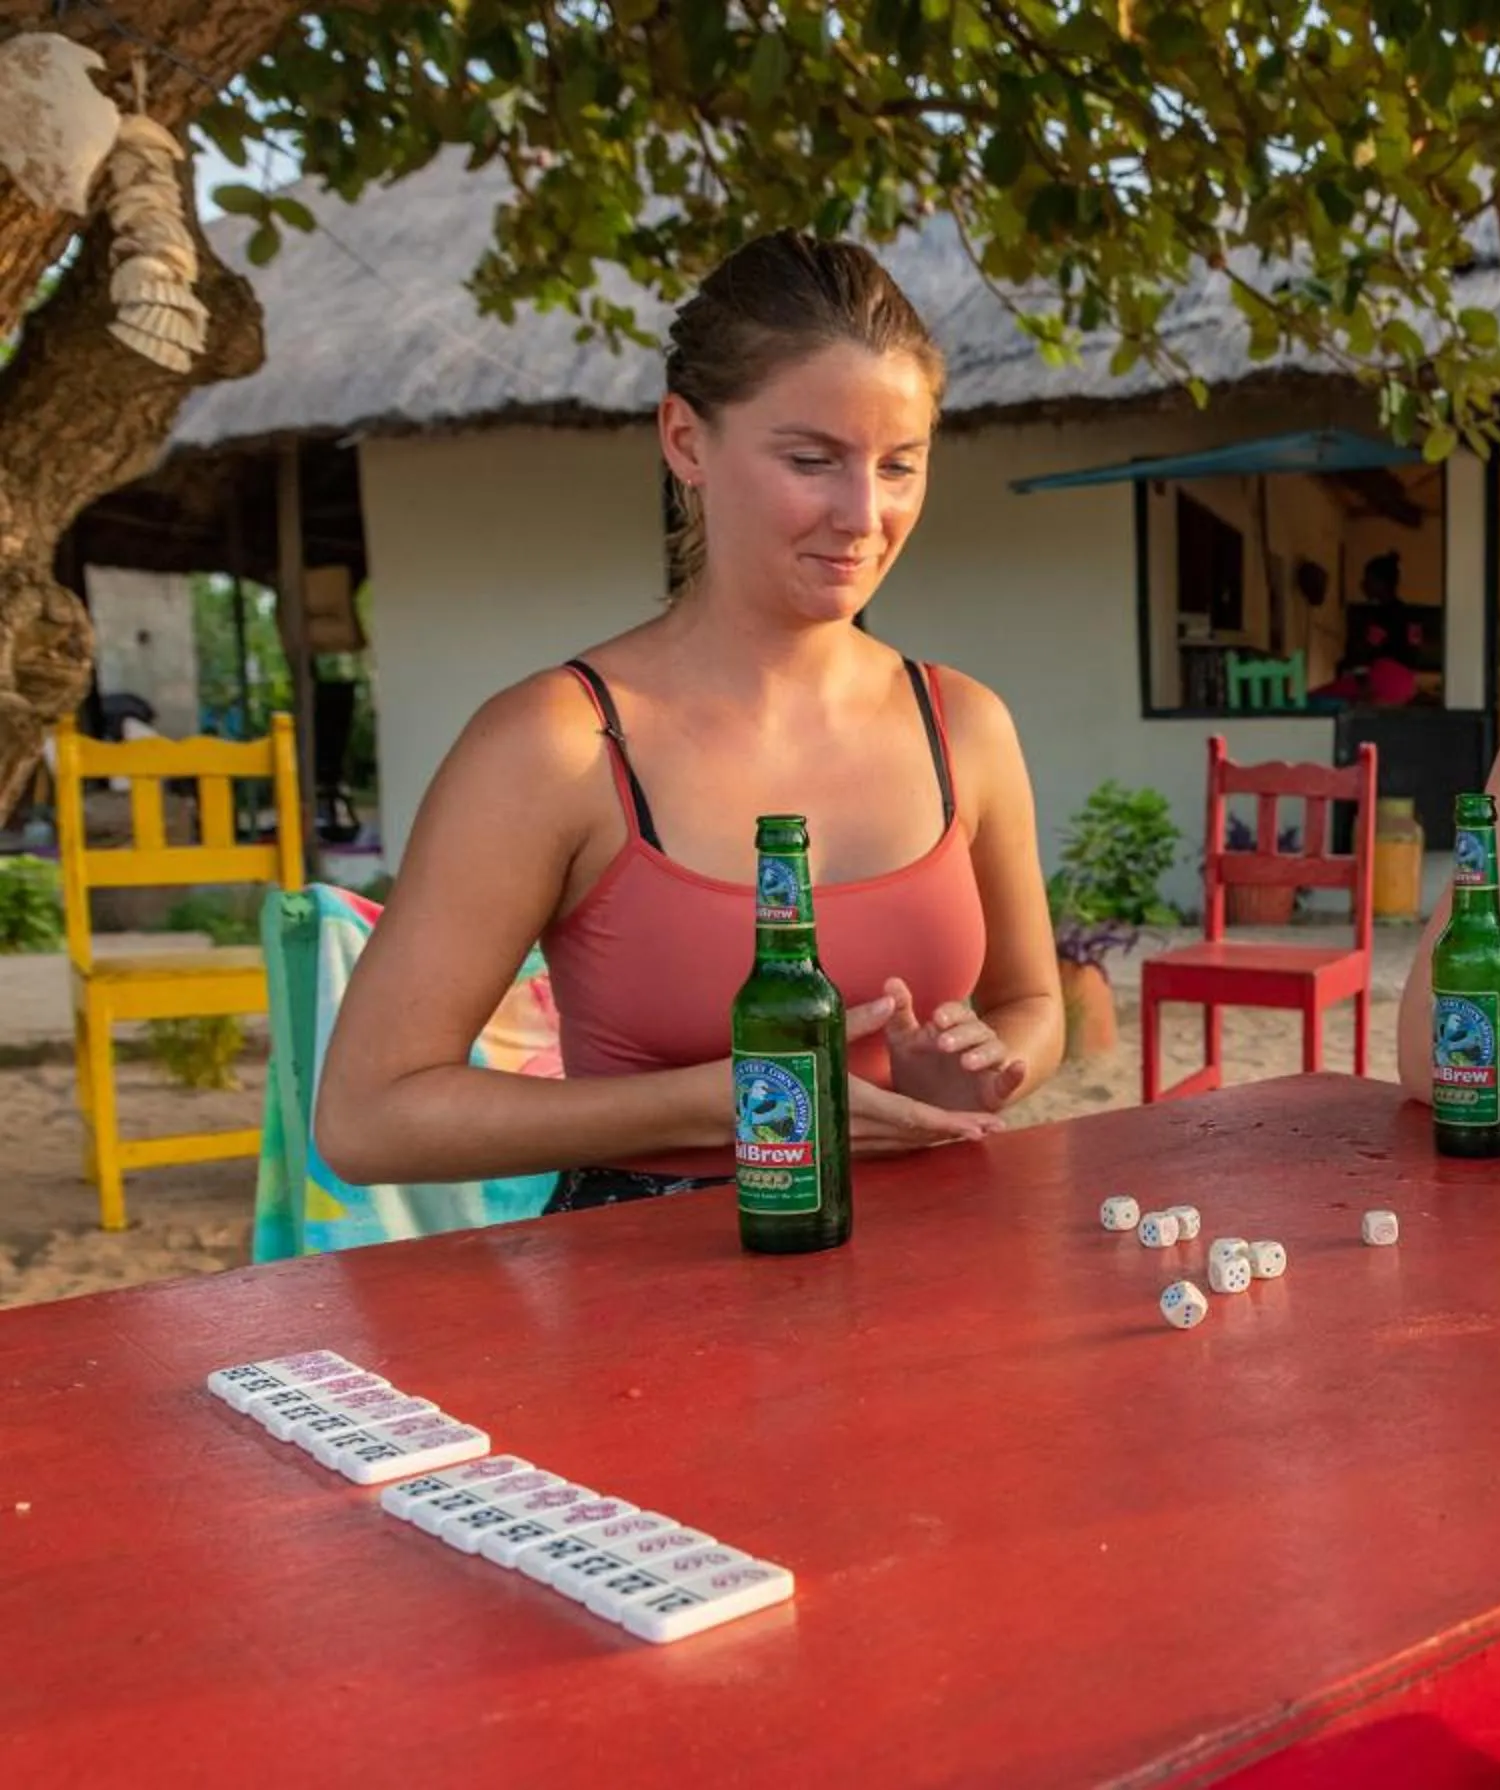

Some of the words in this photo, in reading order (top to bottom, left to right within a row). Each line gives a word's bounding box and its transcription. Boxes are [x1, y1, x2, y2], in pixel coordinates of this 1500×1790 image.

[239, 1378, 279, 1393] 35
[279, 1406, 320, 1421] 33
[307, 1417, 347, 1433] 32
[326, 1433, 367, 1448] 31
[354, 1444, 398, 1463] 30
[397, 1478, 442, 1497] 28
[430, 1493, 475, 1512] 27
[458, 1508, 505, 1529] 26
[497, 1525, 543, 1543] 25
[539, 1539, 586, 1560] 24
[570, 1556, 621, 1577] 23
[606, 1575, 657, 1595] 22
[644, 1592, 694, 1614] 21
